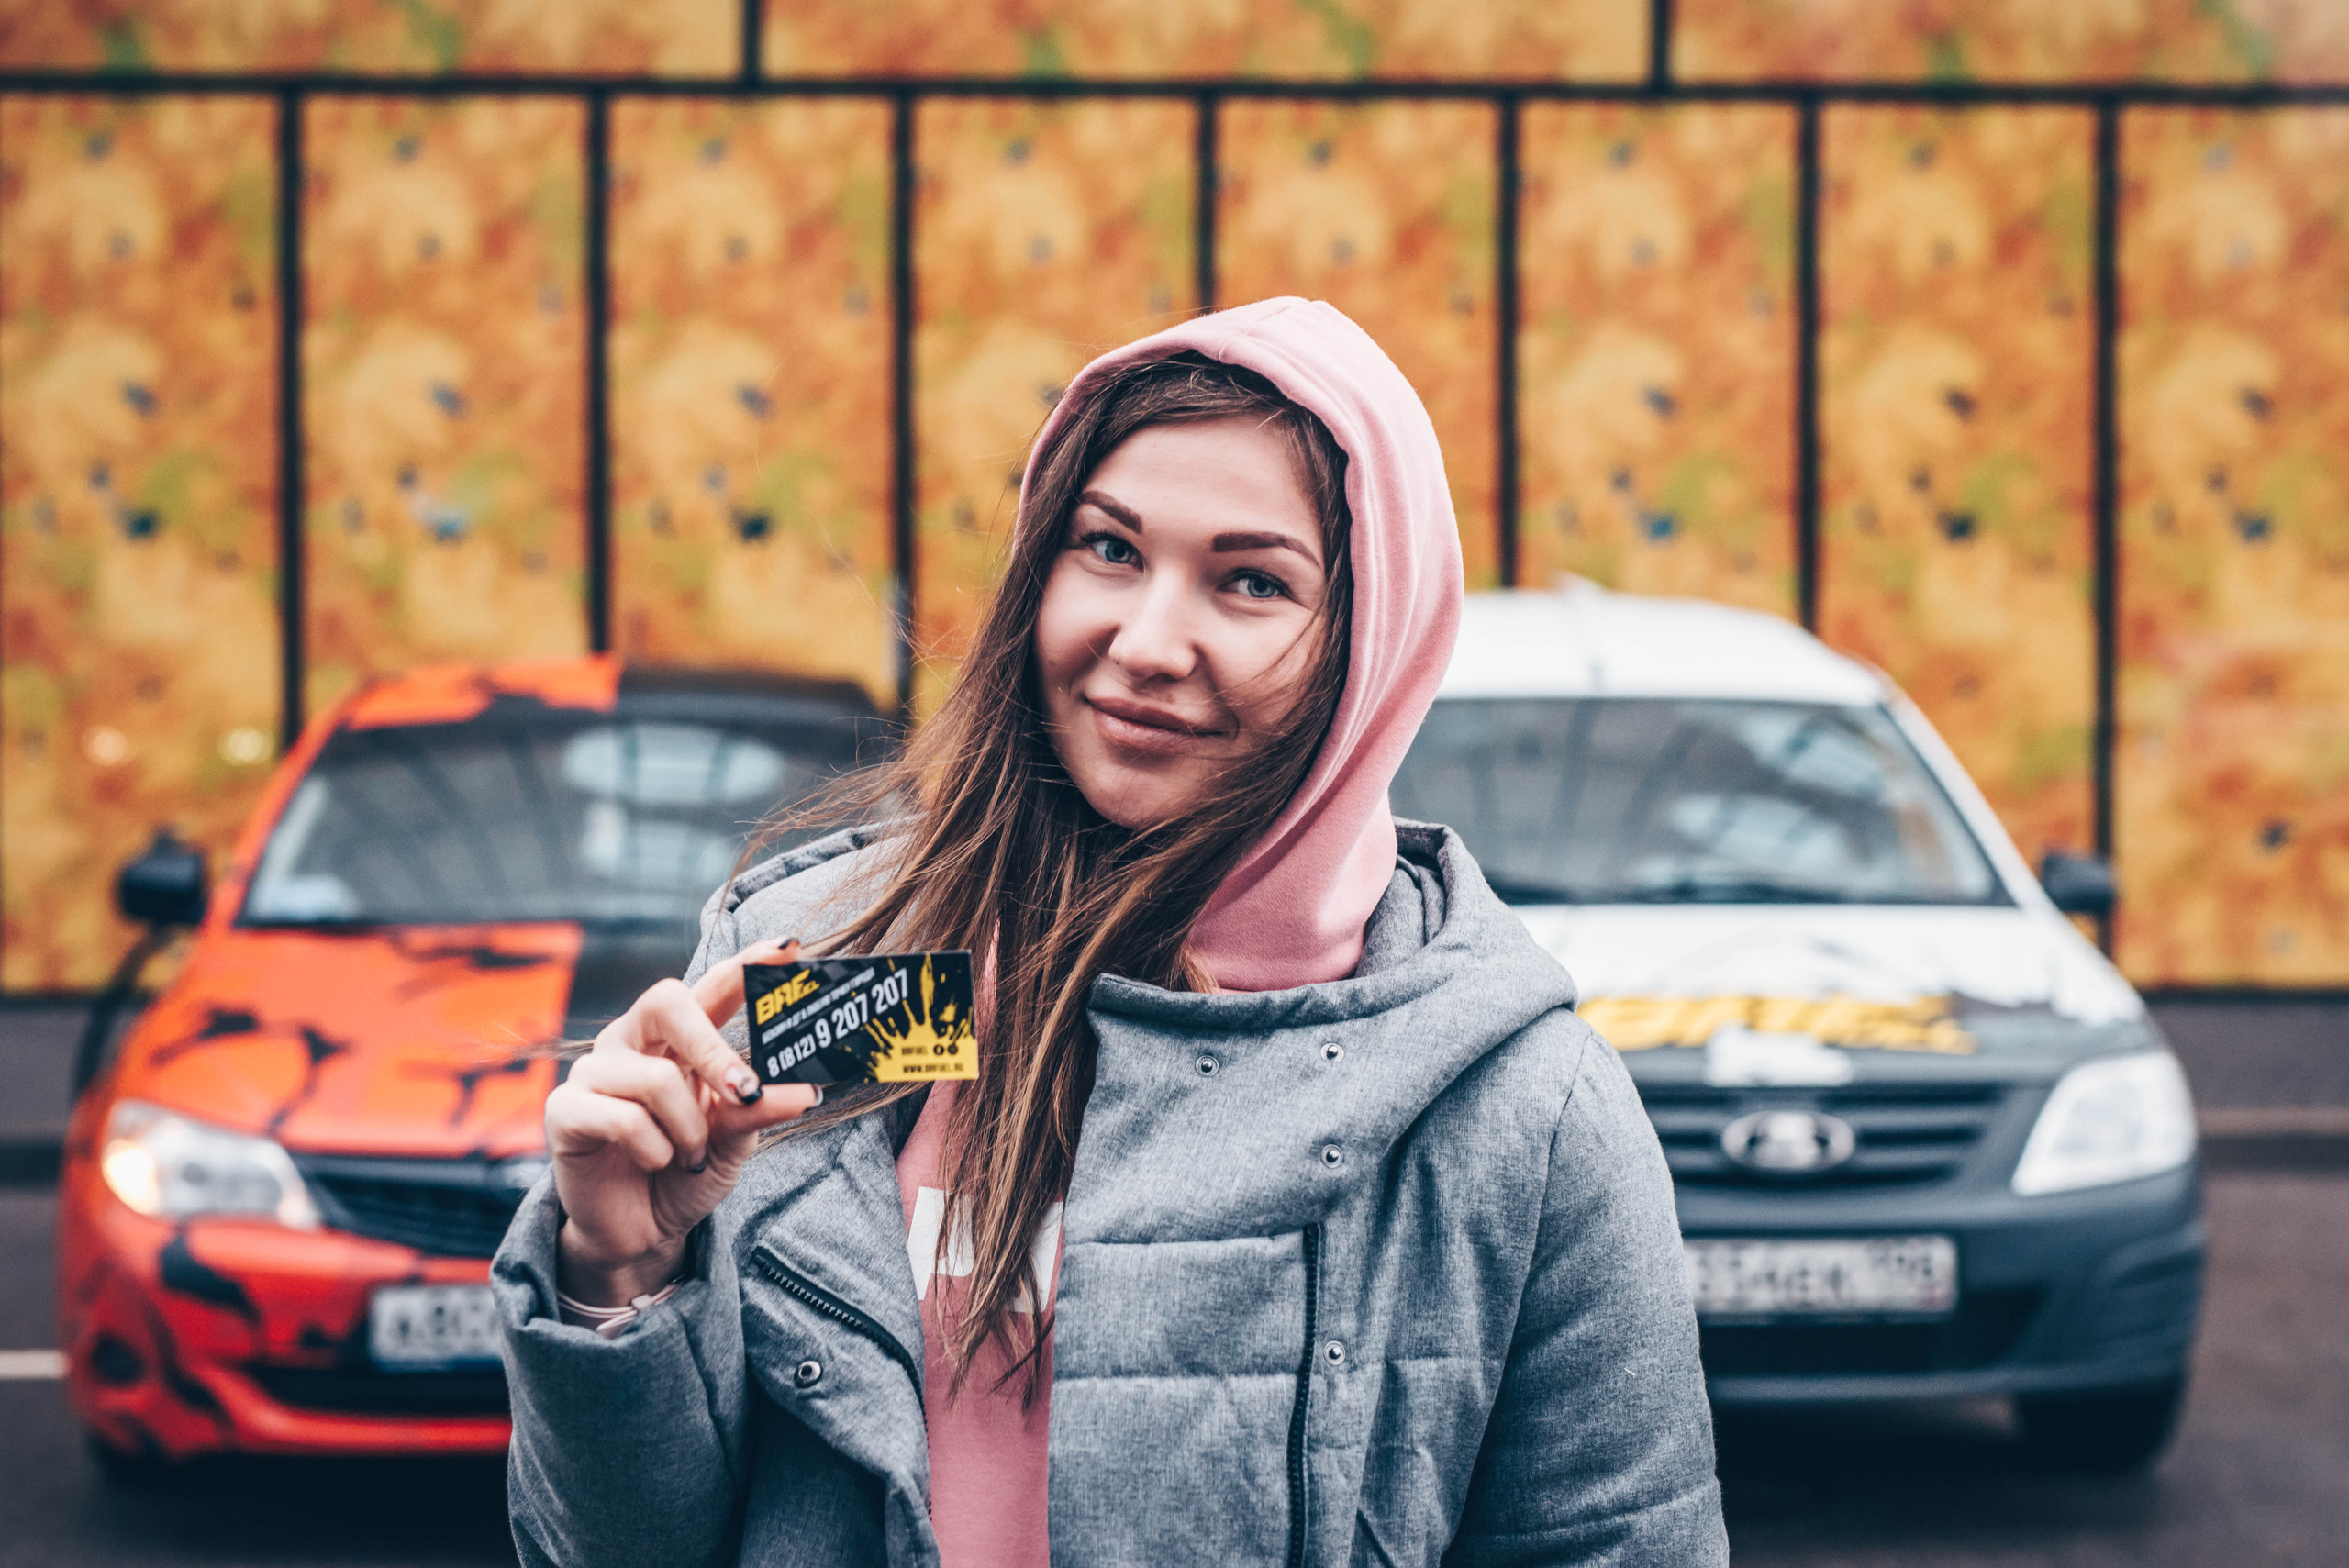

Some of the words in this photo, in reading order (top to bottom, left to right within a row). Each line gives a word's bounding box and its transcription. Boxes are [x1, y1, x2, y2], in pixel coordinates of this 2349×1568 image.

[767, 1056, 780, 1077] 8
[779, 1034, 816, 1071] (812)
[814, 1018, 832, 1049] 9
[831, 993, 869, 1039] 207
[872, 967, 908, 1015] 207
